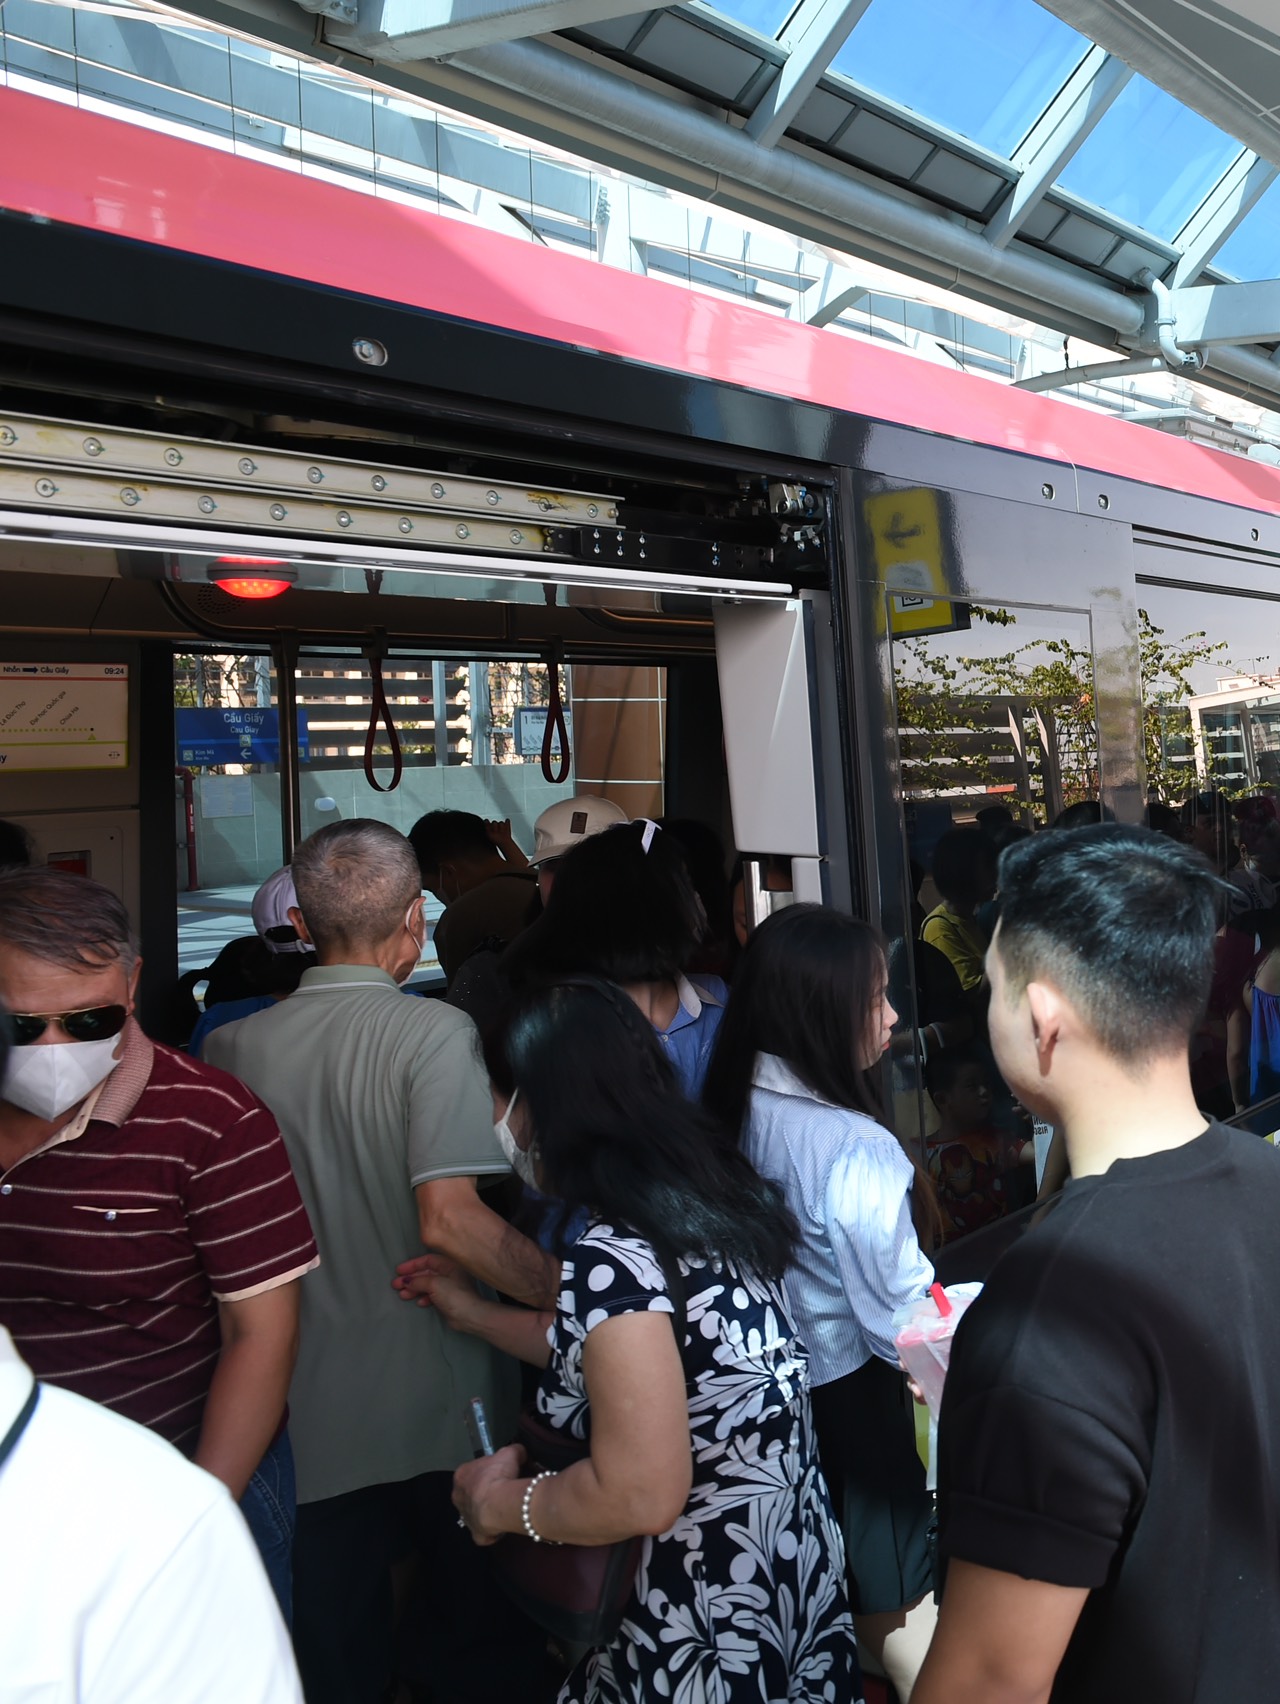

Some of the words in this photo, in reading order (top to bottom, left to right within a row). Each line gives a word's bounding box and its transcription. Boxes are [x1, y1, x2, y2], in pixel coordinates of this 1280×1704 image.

[104, 667, 125, 675] 09:24
[223, 711, 242, 723] Cầu
[244, 711, 264, 725] Giấy
[244, 726, 259, 735] Giay
